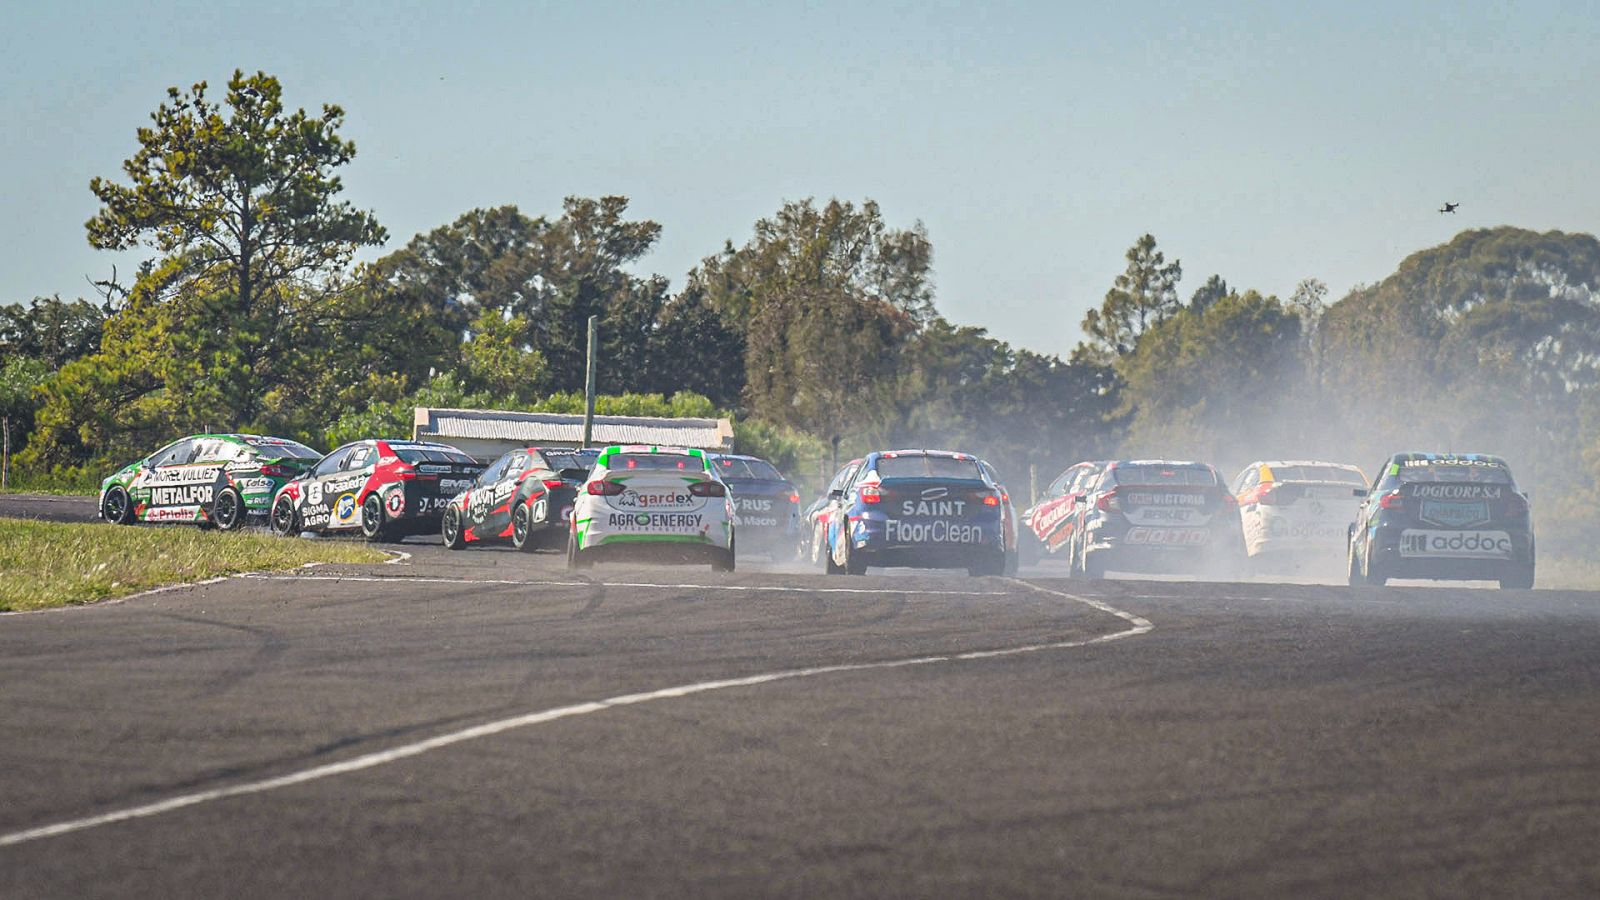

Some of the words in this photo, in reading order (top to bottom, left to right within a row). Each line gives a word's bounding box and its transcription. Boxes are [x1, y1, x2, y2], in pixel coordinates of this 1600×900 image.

[151, 485, 213, 505] METALFOR
[1411, 485, 1482, 498] LOGICORP
[638, 491, 694, 507] gardex
[742, 499, 772, 511] RUS
[1153, 493, 1205, 505] VICTORIA
[301, 504, 330, 516] SIGMA
[902, 500, 966, 516] SAINT
[304, 514, 331, 527] AGRO
[743, 516, 777, 526] Macro
[885, 519, 982, 544] FloorClean
[1431, 532, 1511, 553] addoc
